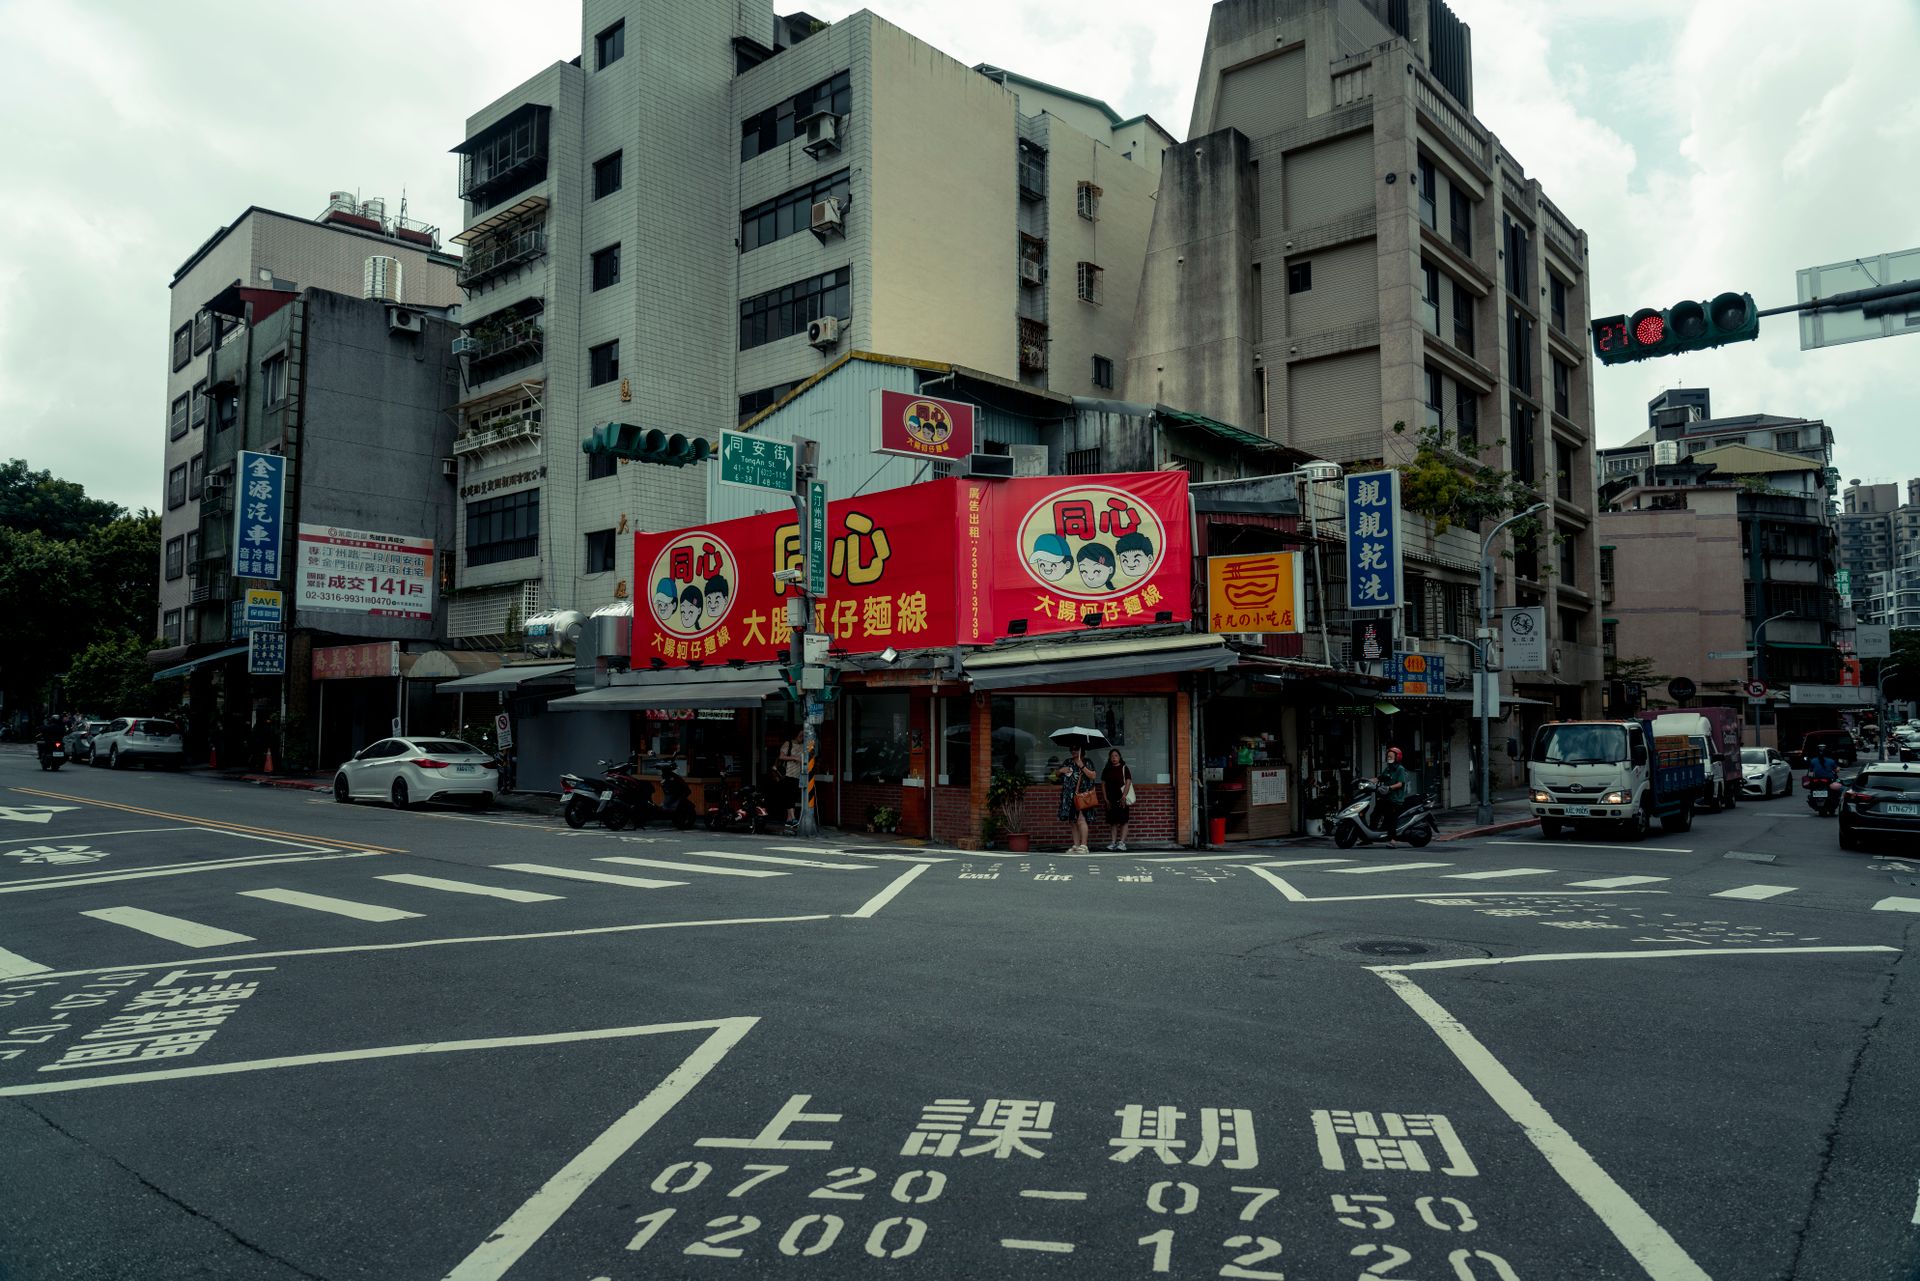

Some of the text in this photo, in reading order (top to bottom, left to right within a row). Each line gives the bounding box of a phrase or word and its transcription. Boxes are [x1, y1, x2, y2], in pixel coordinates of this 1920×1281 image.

[917, 405, 945, 422] 同心
[731, 436, 786, 460] 同安街
[244, 457, 277, 546] 金源汽車
[1053, 498, 1141, 541] 同心
[813, 495, 823, 552] 汀州路二段
[1353, 480, 1389, 601] 親親乾洗
[322, 546, 424, 567] 汀州路二段/同安街
[670, 542, 723, 584] 同心
[252, 597, 278, 607] SAVE
[1213, 610, 1291, 629] 貢丸の小吃店
[651, 625, 731, 660] 大腸蚵仔麵線
[693, 1094, 1479, 1177] 上課期間
